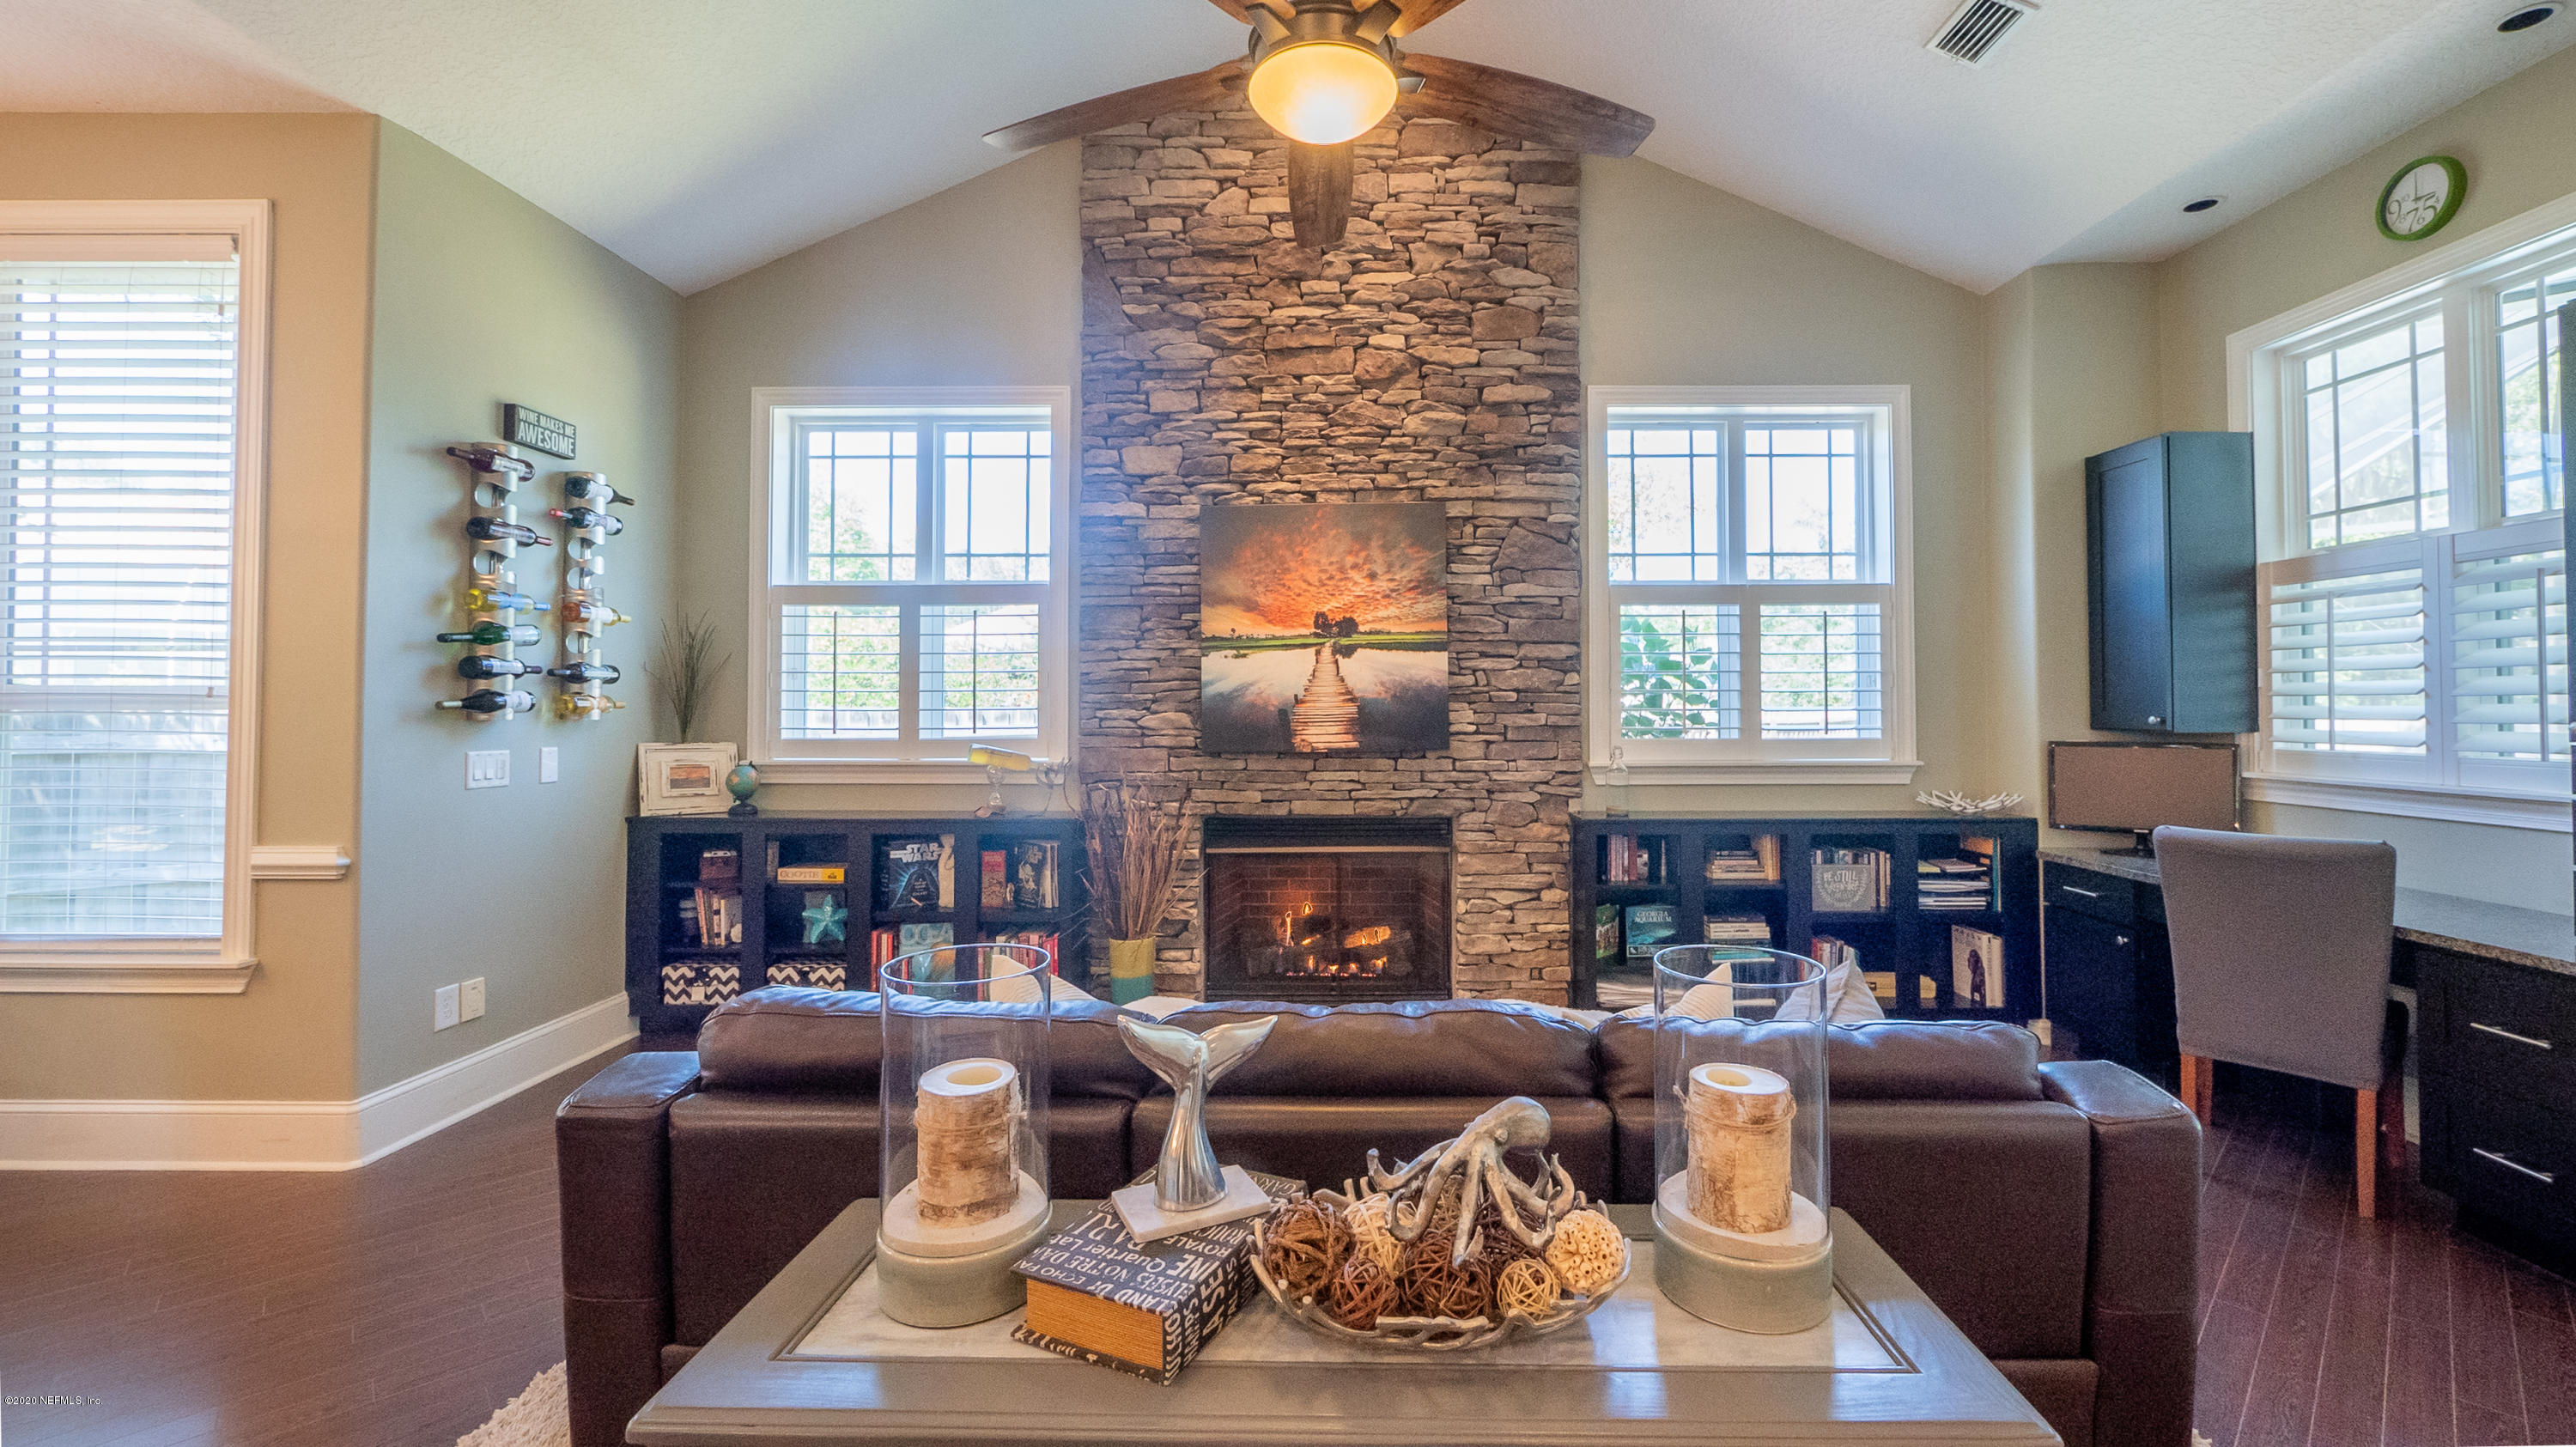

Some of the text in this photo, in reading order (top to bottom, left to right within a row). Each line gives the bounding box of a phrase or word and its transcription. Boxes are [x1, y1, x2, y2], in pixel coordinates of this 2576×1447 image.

[2387, 199, 2402, 226] 9
[2406, 207, 2420, 233] 7
[519, 407, 574, 438] WINE MAKES ME
[518, 421, 574, 457] AWESOME
[899, 842, 941, 854] STAR
[899, 852, 941, 863] WARS
[1049, 1234, 1166, 1273] Quartier Lat
[1163, 1235, 1233, 1257] ROYALE
[1041, 1267, 1086, 1285] ECHO
